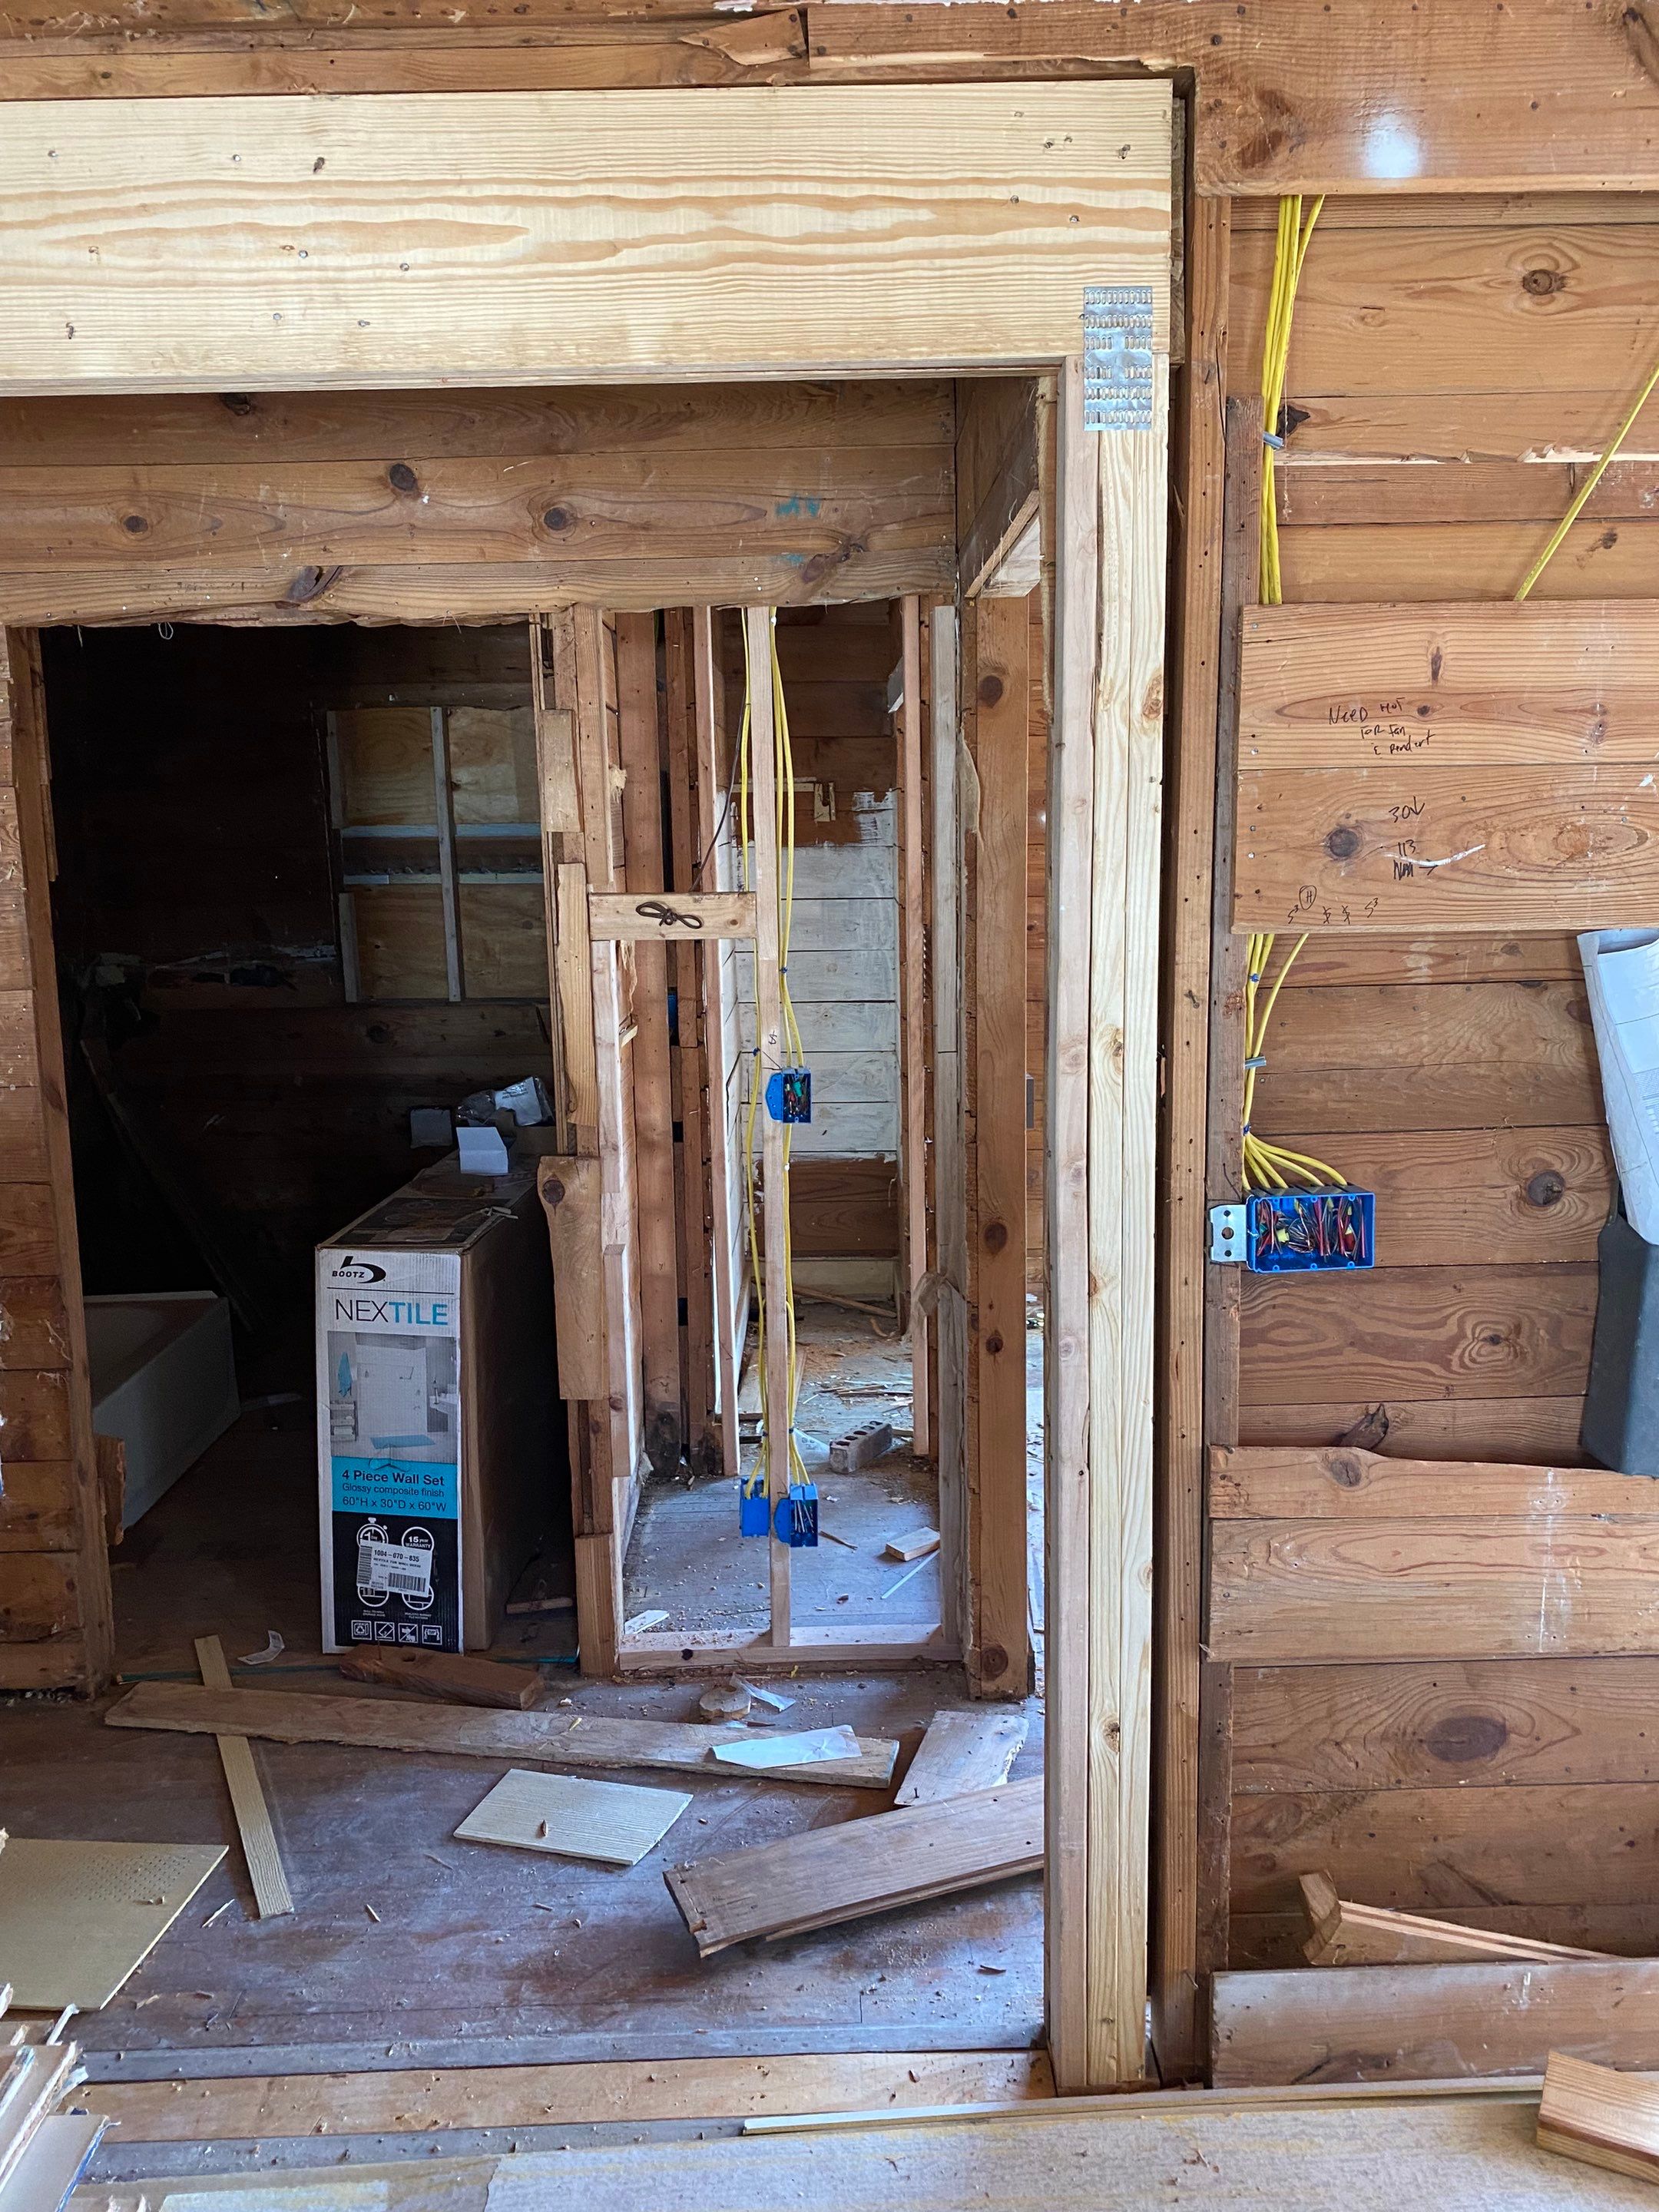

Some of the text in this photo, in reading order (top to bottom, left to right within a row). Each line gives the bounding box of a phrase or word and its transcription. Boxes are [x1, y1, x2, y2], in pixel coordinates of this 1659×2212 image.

[336, 1299, 449, 1326] NEXTILE
[342, 1470, 444, 1485] 4 Piece Wall Set
[343, 1483, 444, 1497] Glossy composite finish
[343, 1497, 368, 1506] 60"H
[381, 1498, 406, 1508] 30"D
[419, 1502, 446, 1512] 60"W
